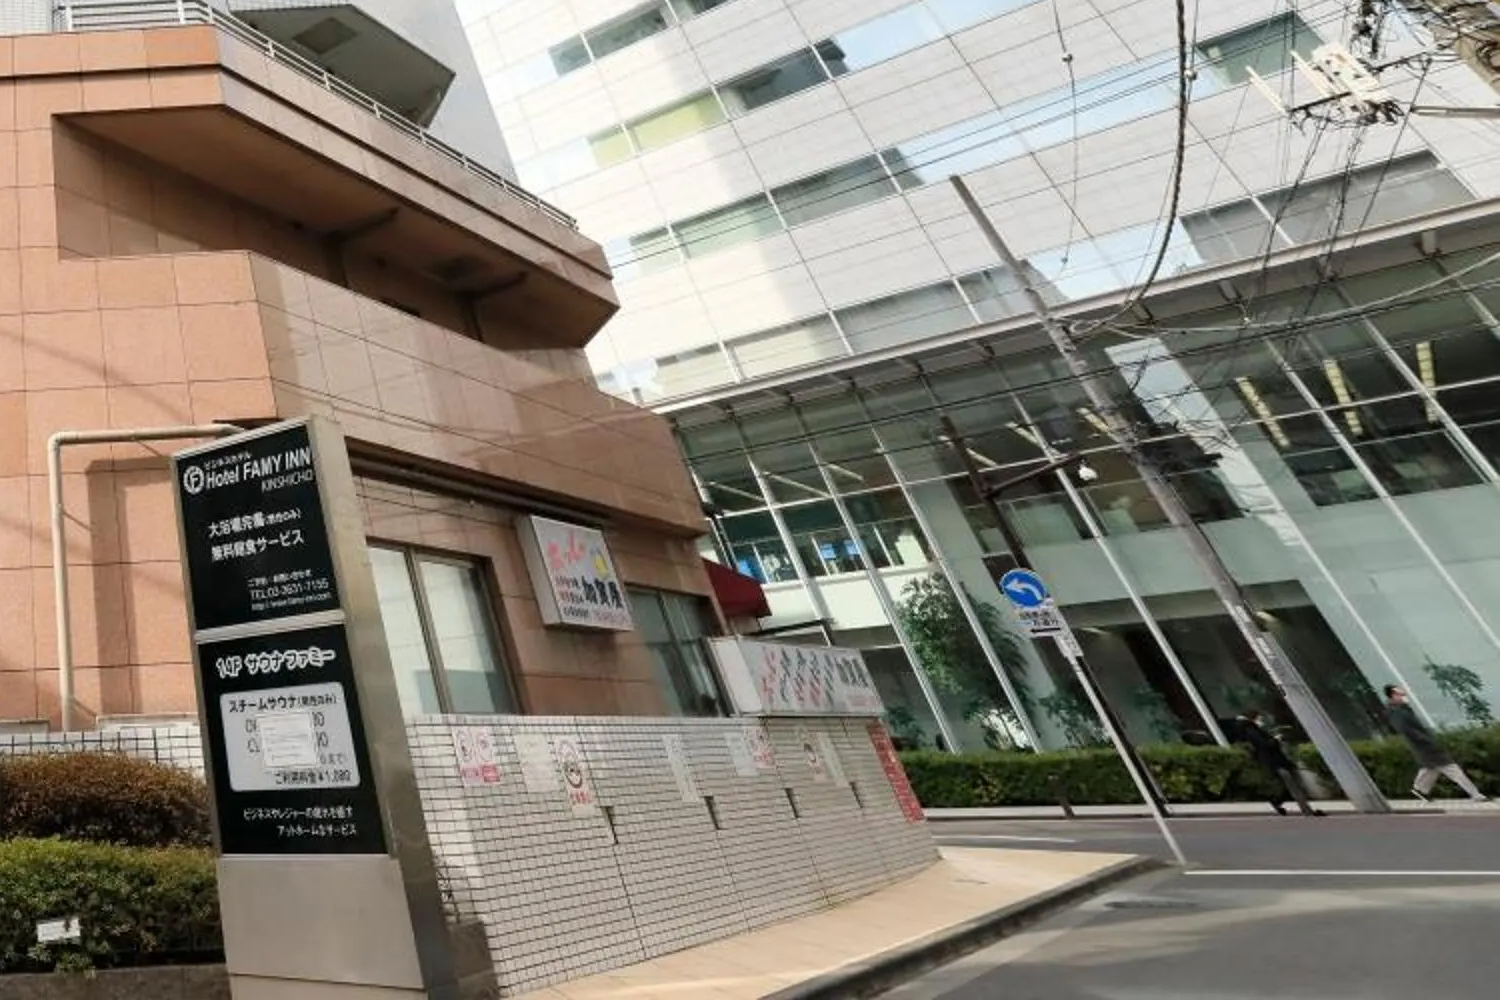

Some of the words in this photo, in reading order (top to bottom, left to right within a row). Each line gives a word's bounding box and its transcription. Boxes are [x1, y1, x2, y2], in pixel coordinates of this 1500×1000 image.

[205, 464, 240, 489] Hotel
[243, 453, 282, 481] FAMY
[285, 445, 312, 471] INN
[261, 468, 313, 493] KINSHICHO
[216, 655, 243, 679] 14F
[244, 645, 337, 675] サウナファミー
